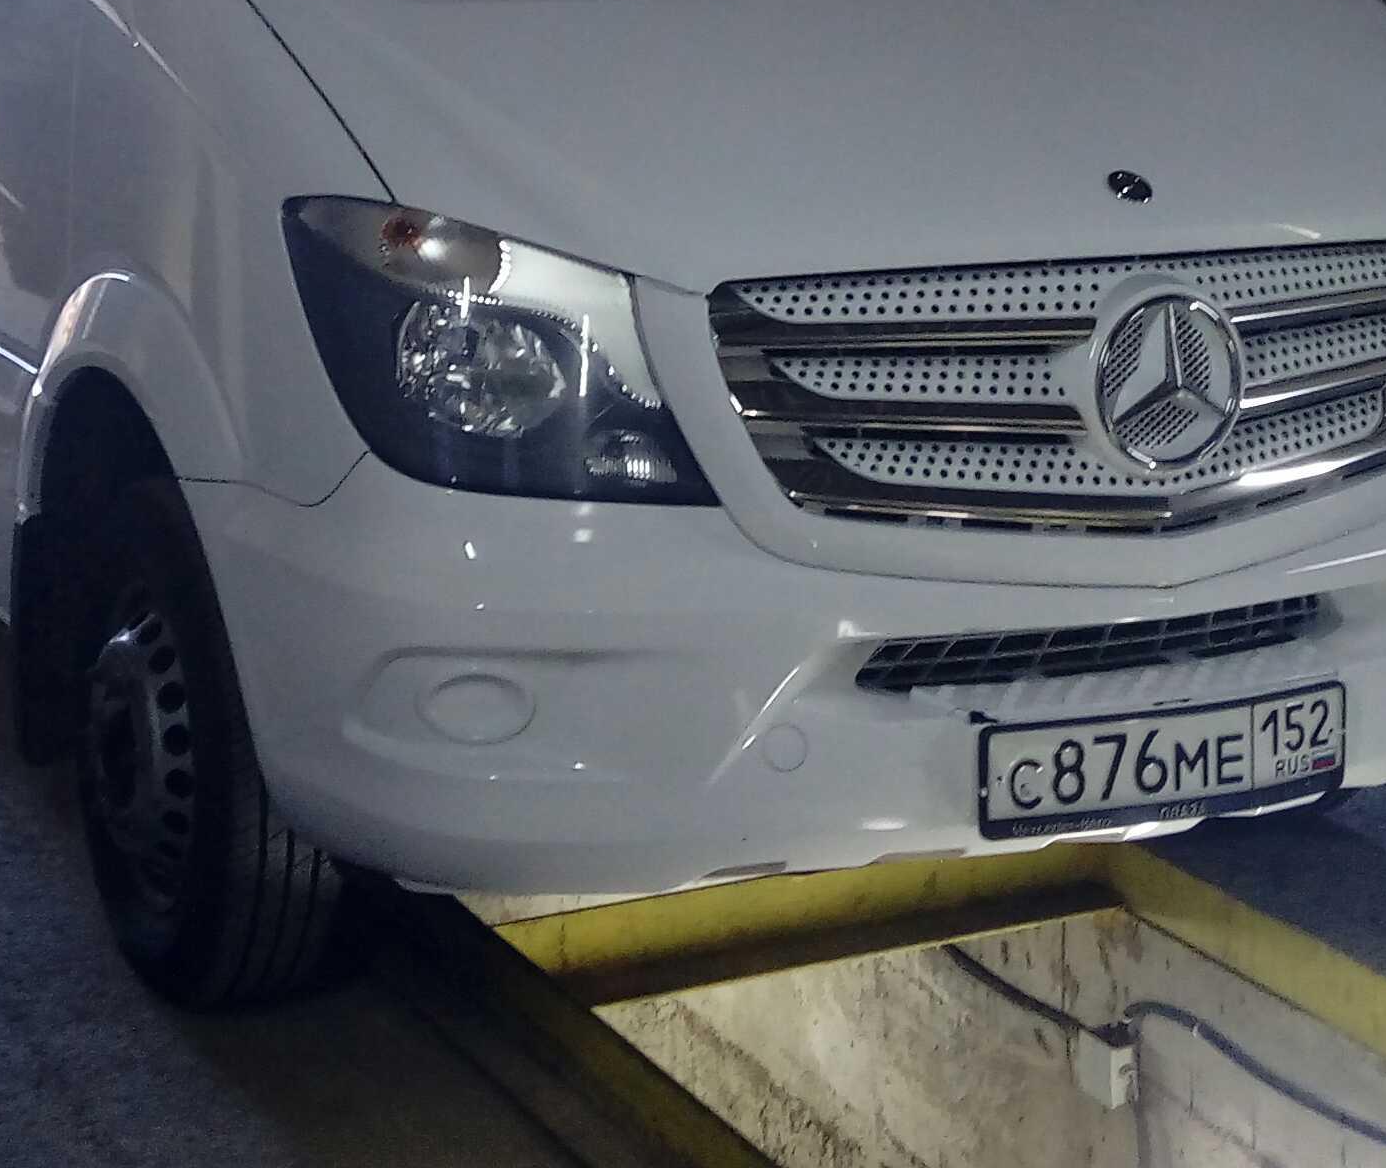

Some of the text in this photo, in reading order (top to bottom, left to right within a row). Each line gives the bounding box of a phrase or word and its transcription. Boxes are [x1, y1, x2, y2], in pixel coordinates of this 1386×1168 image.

[1008, 699, 1334, 810] С876МЕ 152
[1274, 756, 1311, 780] RUS
